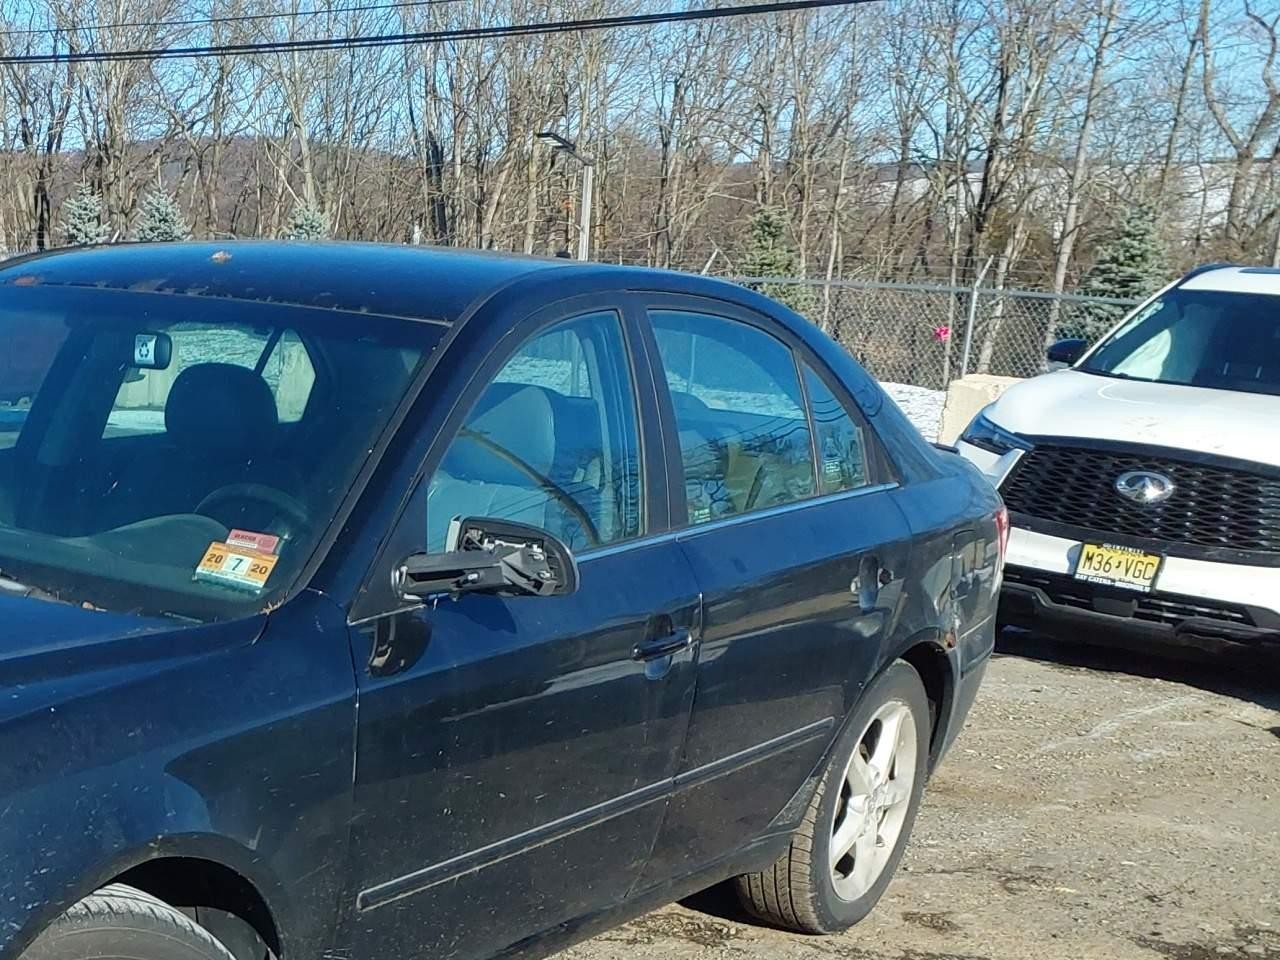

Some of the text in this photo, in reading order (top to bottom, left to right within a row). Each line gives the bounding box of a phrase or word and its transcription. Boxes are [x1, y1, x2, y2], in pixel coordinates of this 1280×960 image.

[207, 553, 268, 574] 20 7 20
